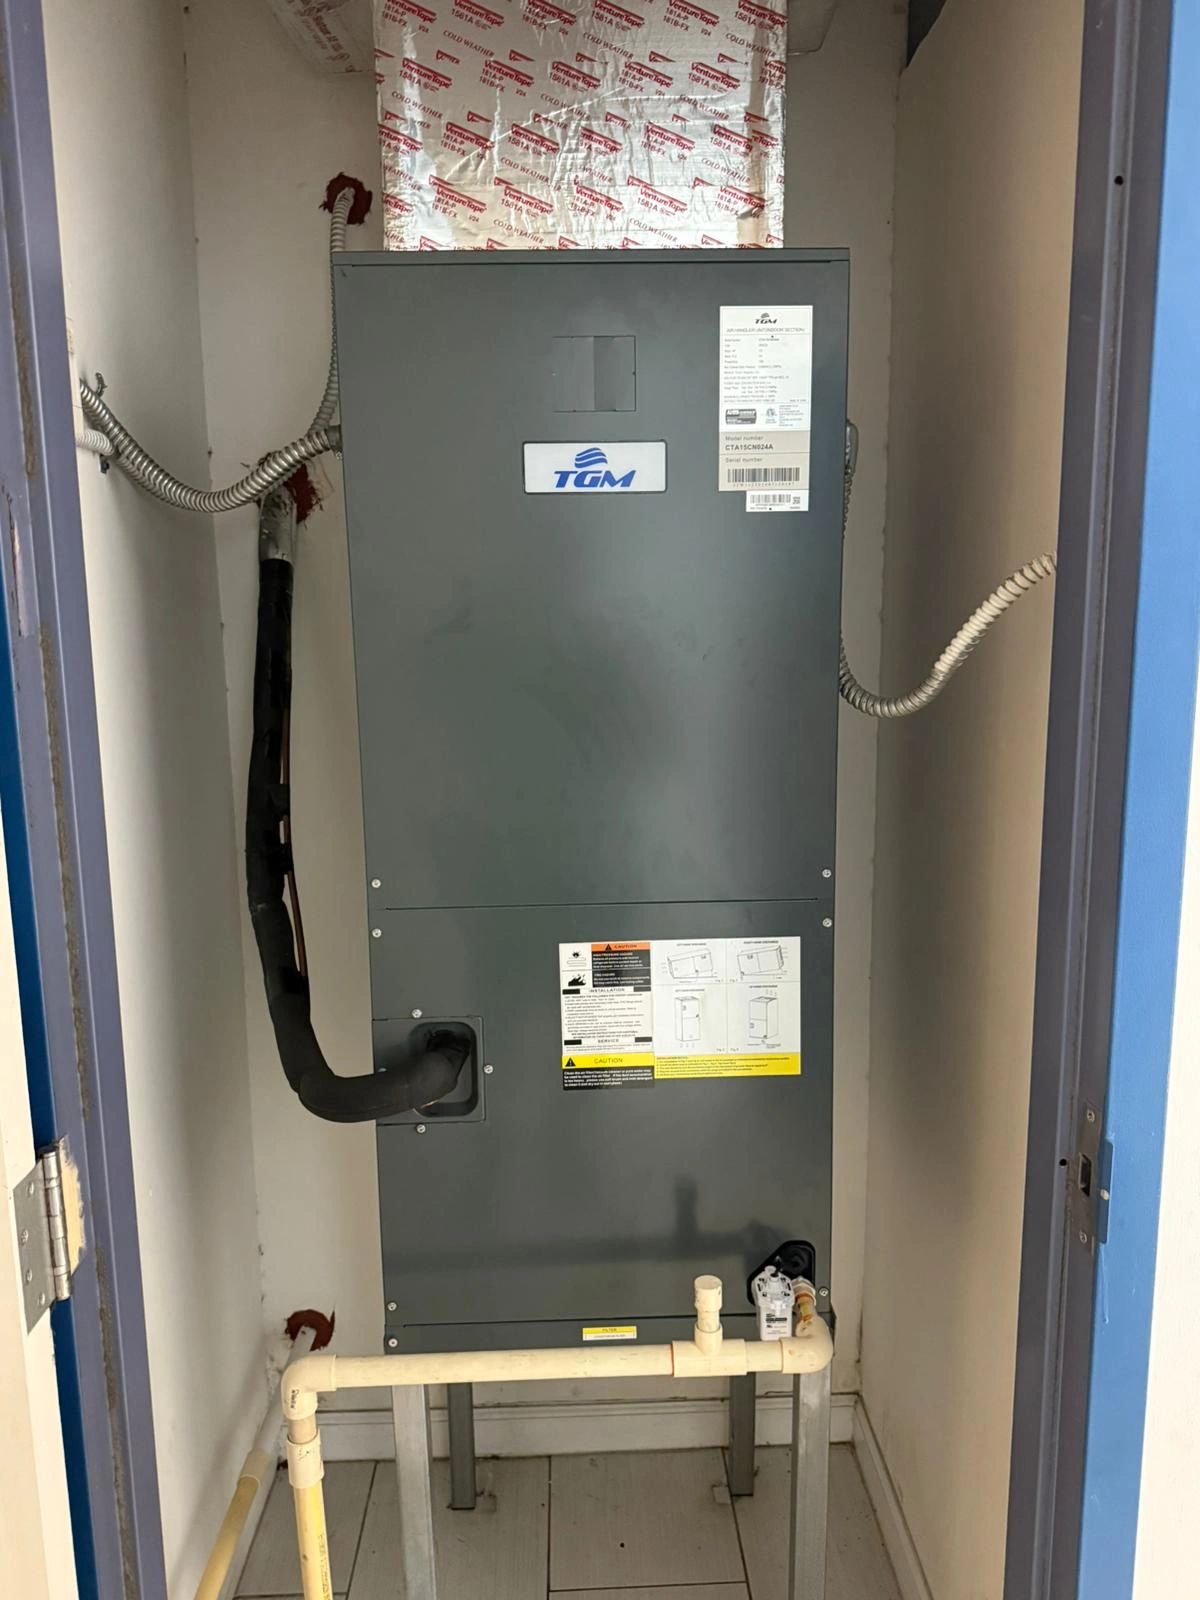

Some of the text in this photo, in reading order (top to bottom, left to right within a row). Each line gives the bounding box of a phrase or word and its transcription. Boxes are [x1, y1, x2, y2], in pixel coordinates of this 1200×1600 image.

[443, 30, 463, 44] COLD
[464, 39, 495, 57] WEATHER
[583, 31, 603, 46] COLD
[726, 32, 745, 46] COLD
[391, 90, 411, 104] COLD
[540, 93, 559, 107] COLD
[501, 157, 519, 170] COLD
[554, 470, 636, 488] TGM
